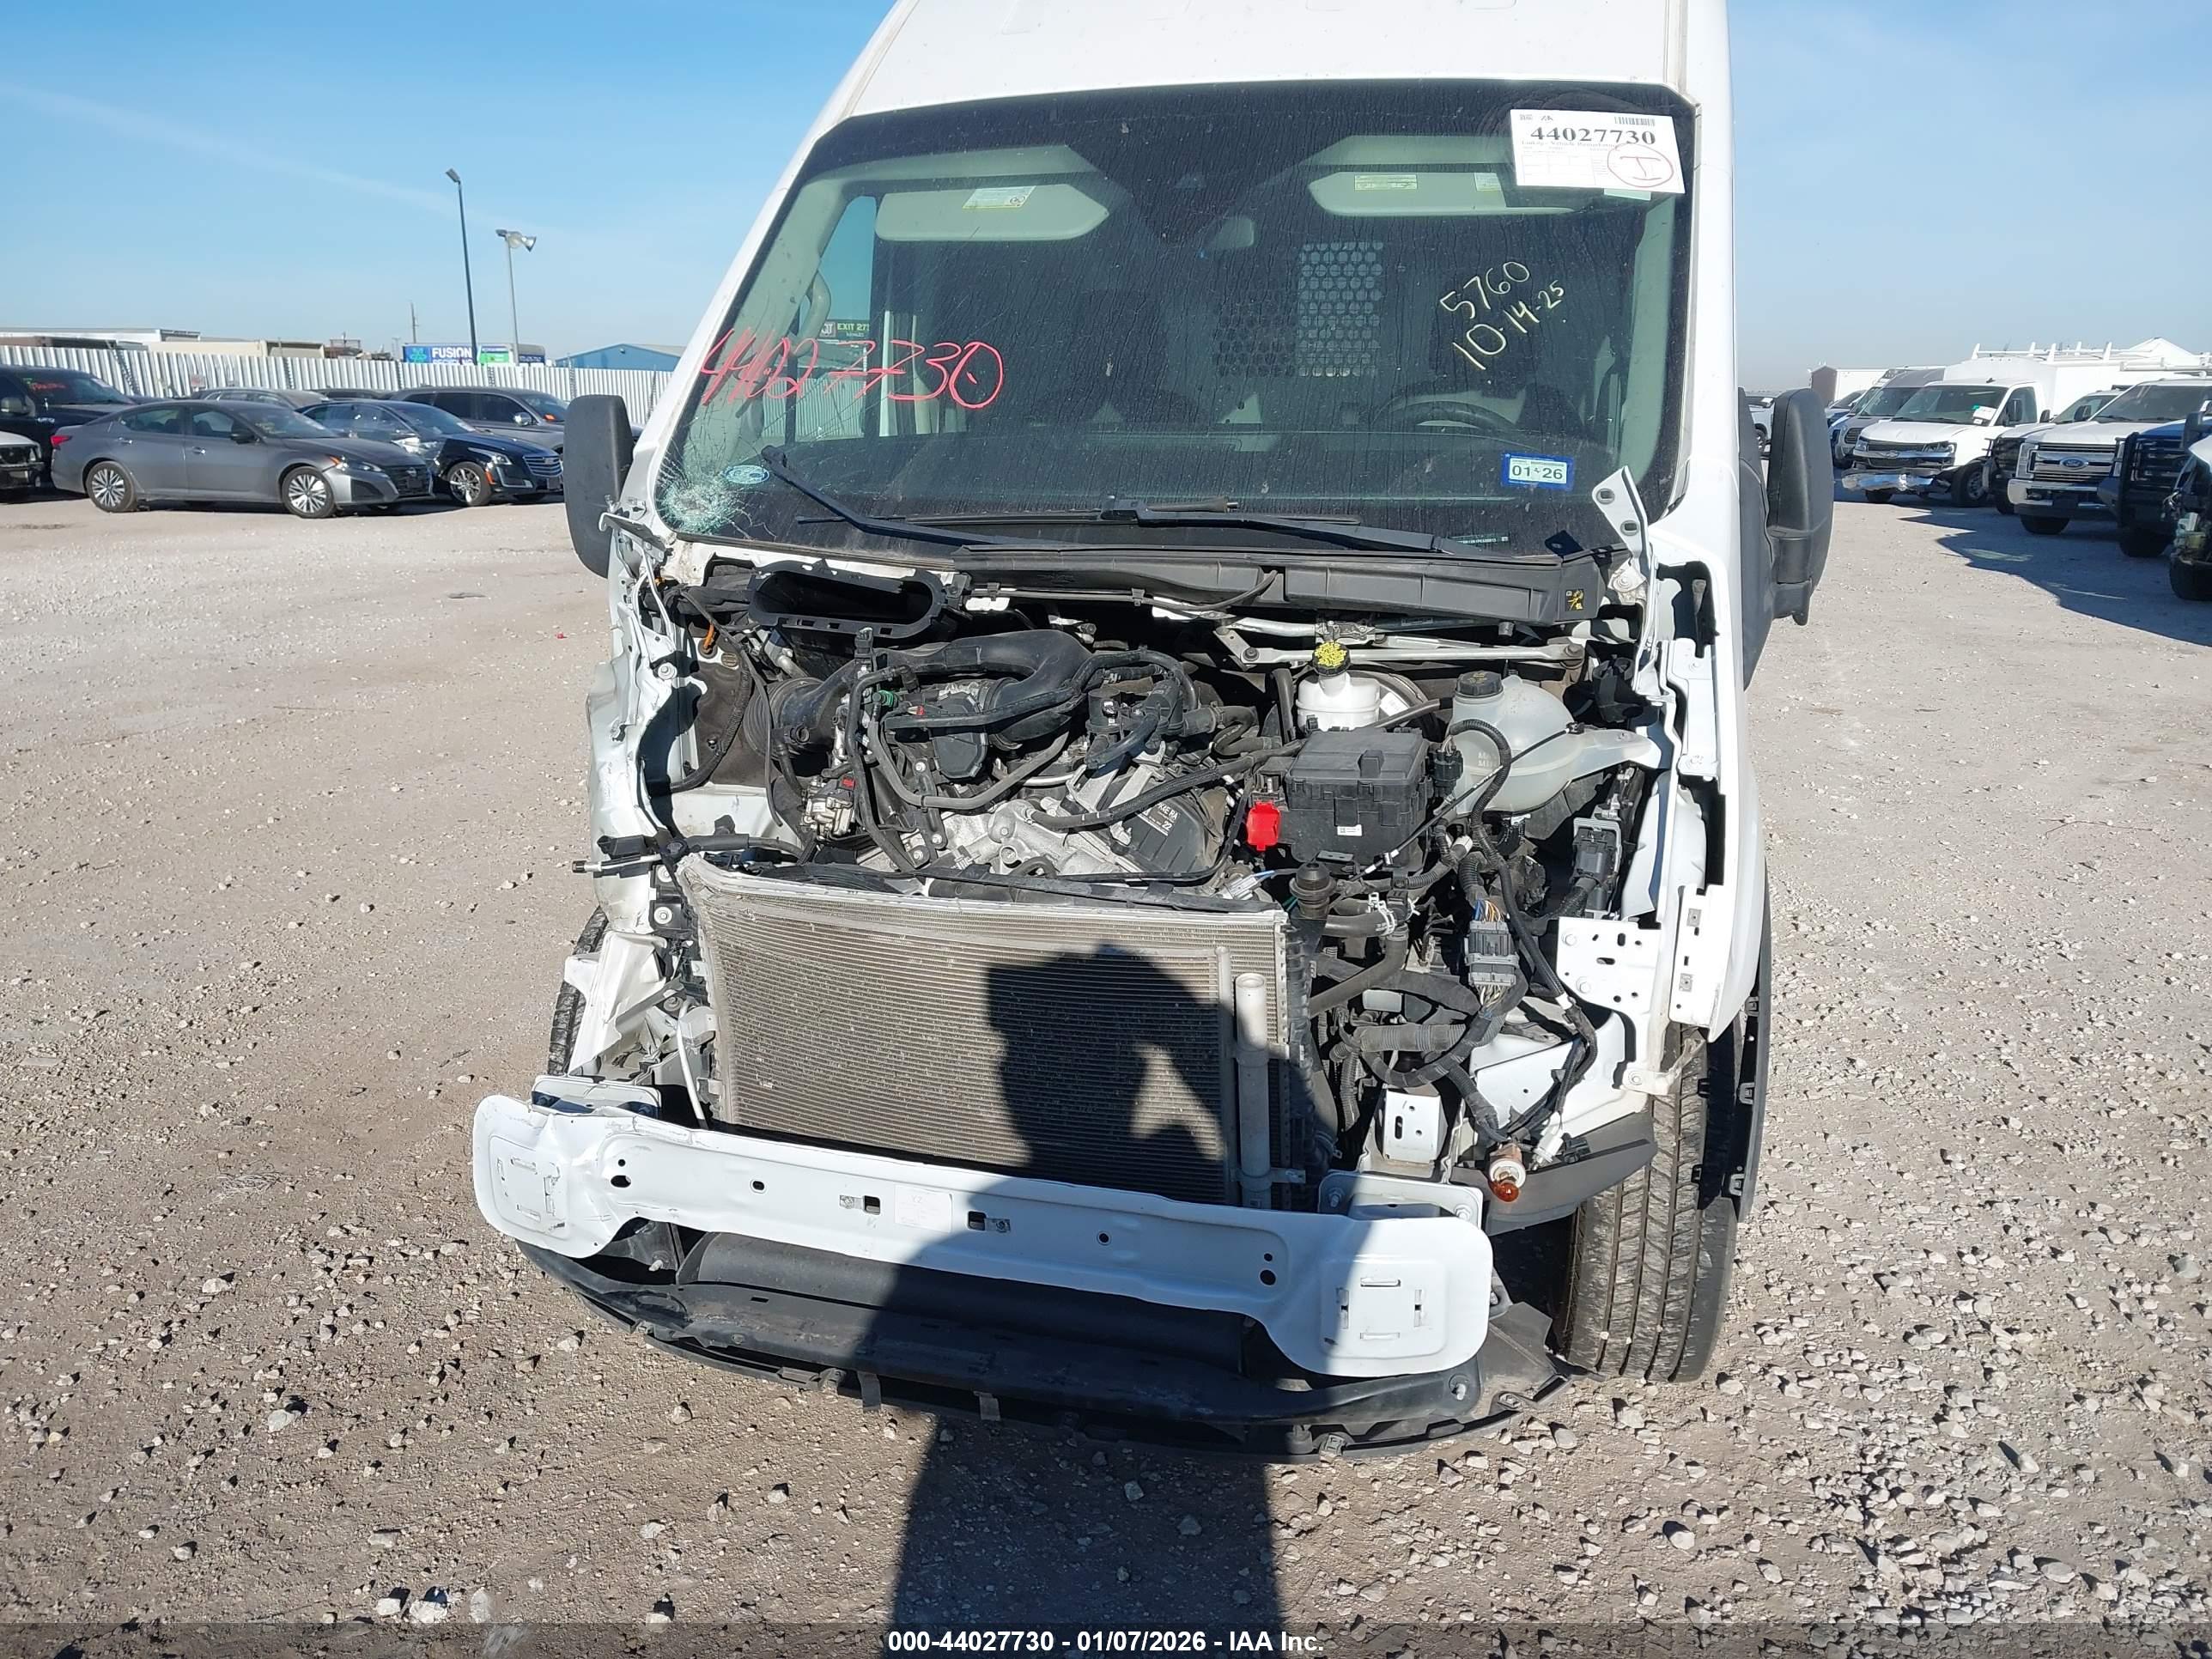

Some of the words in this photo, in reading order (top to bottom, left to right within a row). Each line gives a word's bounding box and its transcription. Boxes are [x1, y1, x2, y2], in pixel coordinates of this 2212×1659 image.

[1530, 126, 1656, 145] 44027730
[1439, 261, 1530, 319] 5760
[432, 347, 472, 358] FUSION
